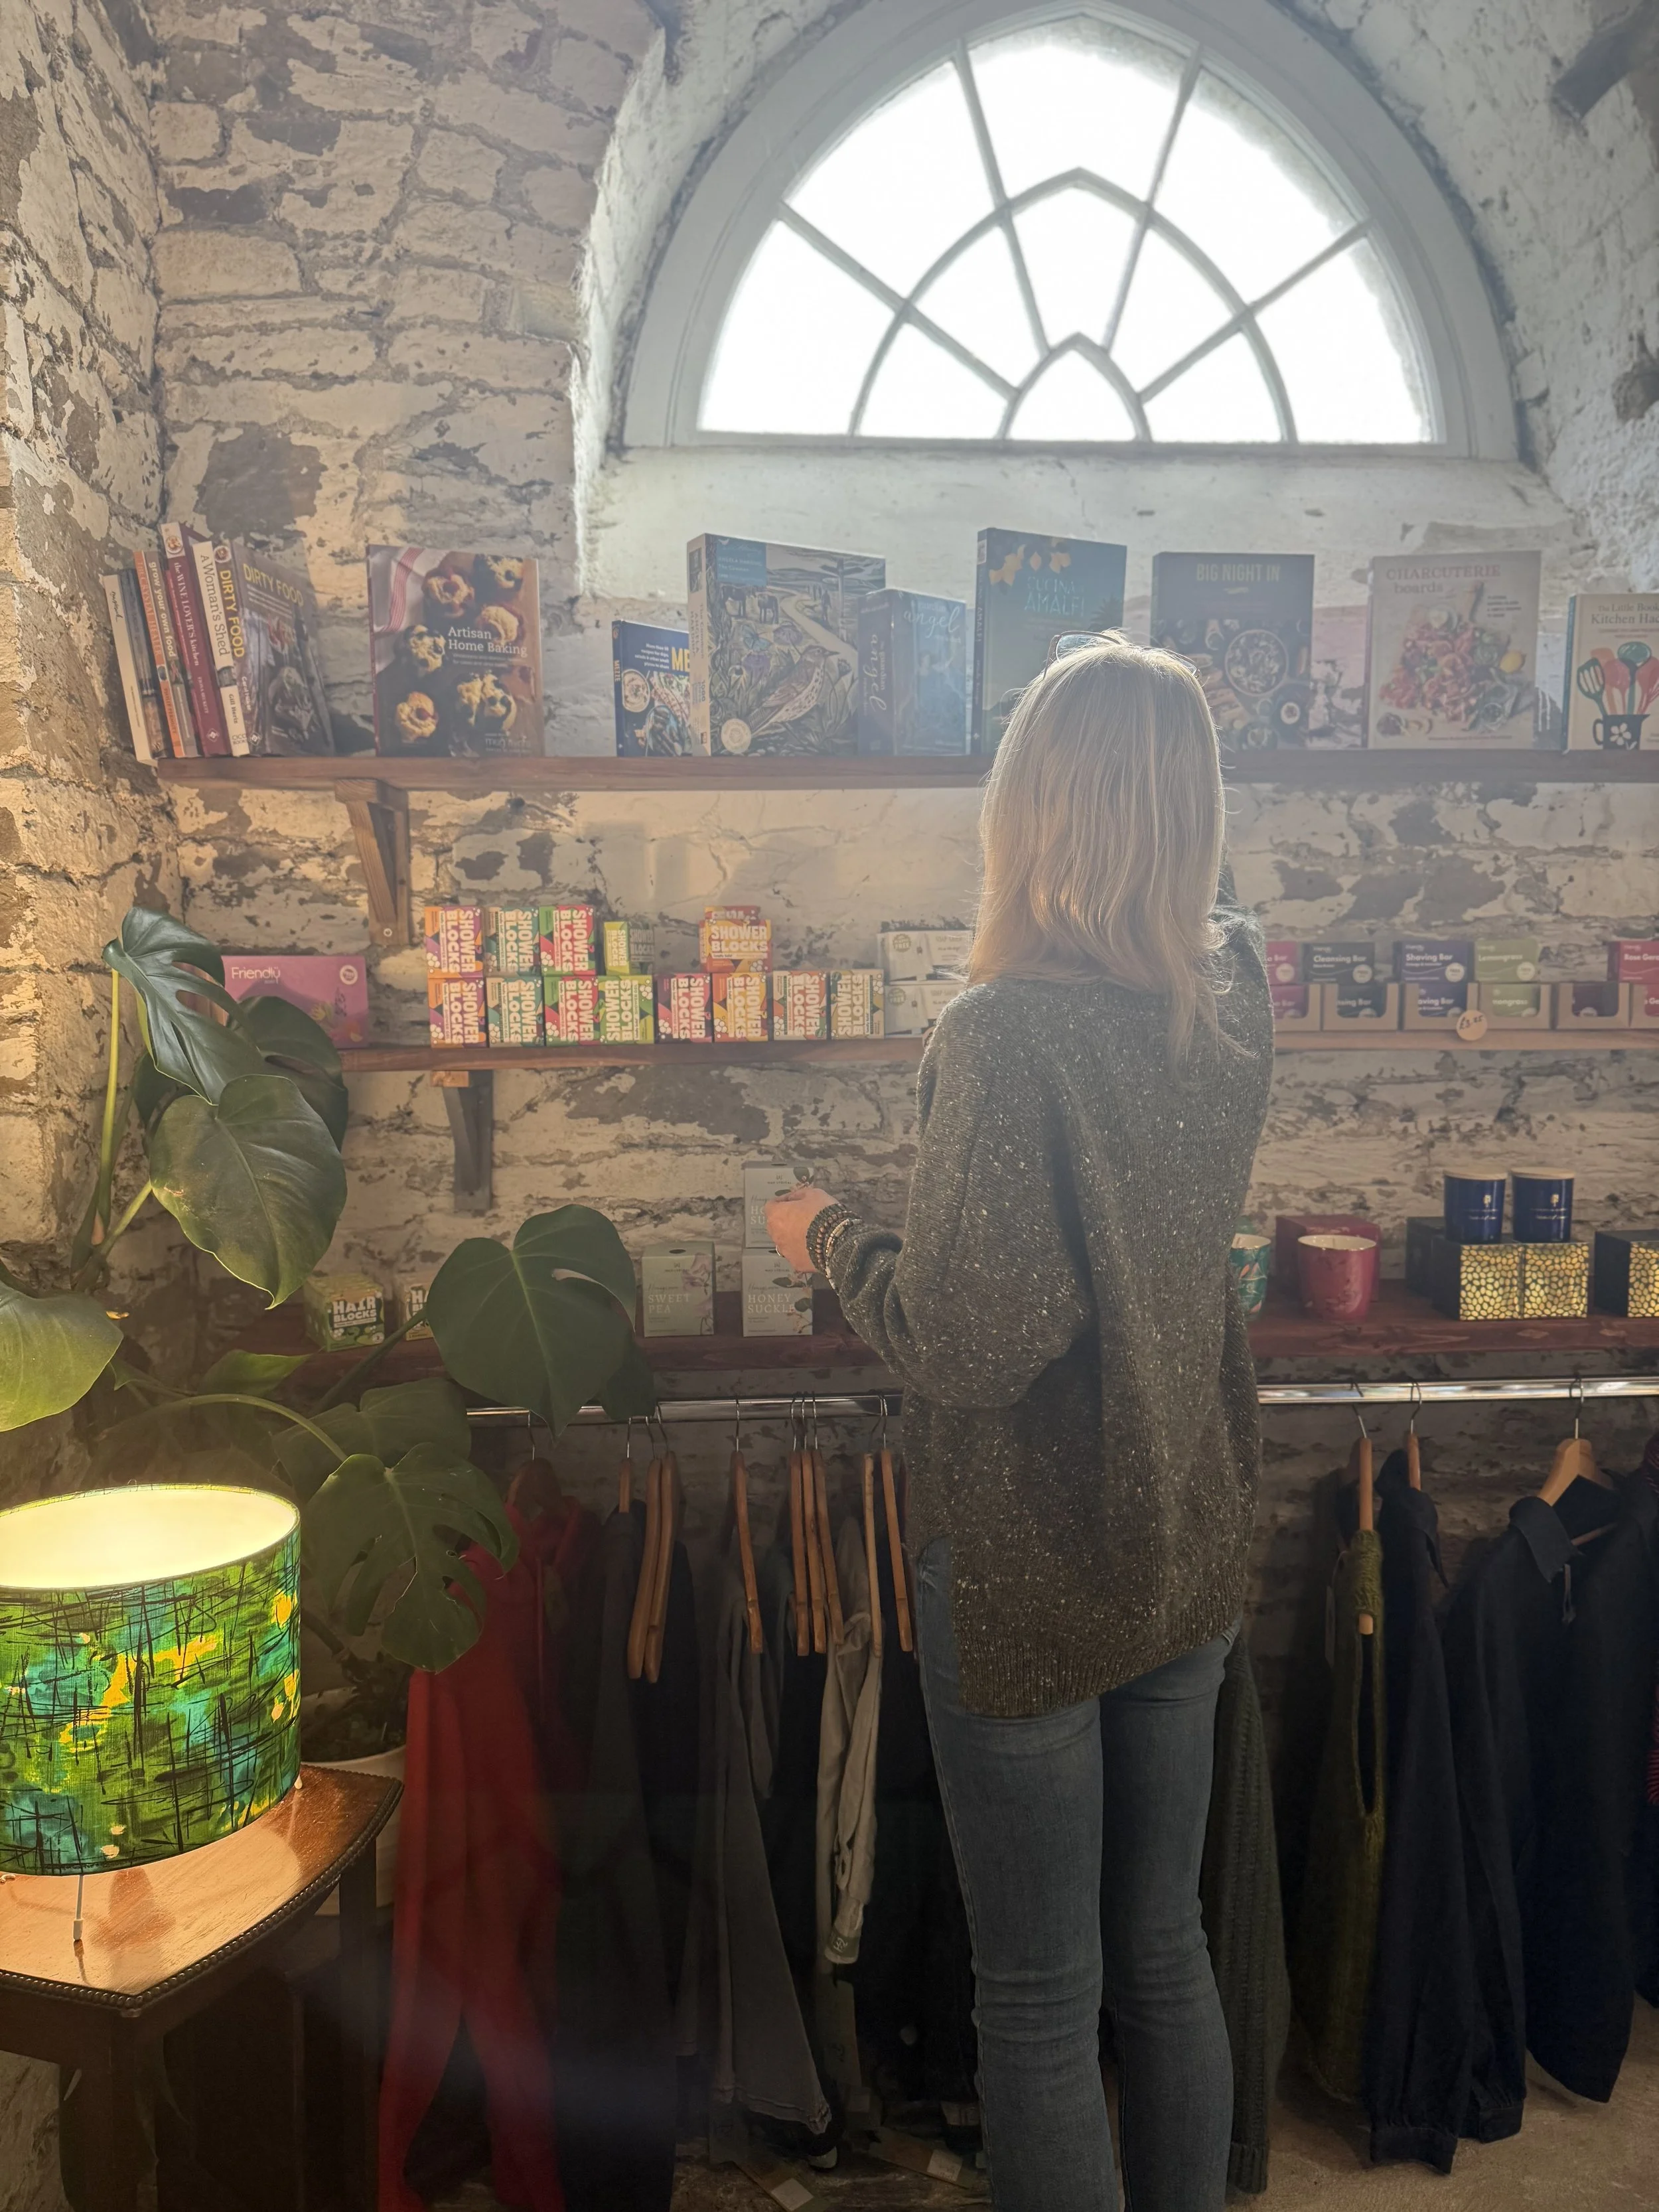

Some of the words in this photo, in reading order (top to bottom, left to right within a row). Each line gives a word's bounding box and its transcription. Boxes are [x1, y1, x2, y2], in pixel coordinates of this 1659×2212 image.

[149, 562, 161, 587] grow
[177, 573, 188, 599] WINE
[242, 563, 273, 592] DIRTY
[276, 580, 304, 607] FOOD
[1027, 576, 1075, 594] CUCINA
[1196, 563, 1218, 581] BIG
[1222, 563, 1263, 582] NIGHT
[1265, 564, 1281, 582] IN
[1386, 564, 1501, 581] CHARCUTERIE
[1394, 581, 1444, 594] boards
[139, 576, 152, 616] CRYSTAL
[154, 589, 165, 610] your
[202, 564, 221, 623] Woman's
[214, 623, 230, 656] Shed
[1024, 591, 1085, 617] AMALFI
[1612, 603, 1634, 612] Little
[160, 613, 170, 634] own
[181, 600, 194, 638] LOVER'S
[220, 569, 237, 612] DIRTY
[229, 617, 245, 658] FOOD
[904, 604, 961, 638] angel
[1591, 613, 1635, 624] Kitchen
[165, 636, 176, 657] food
[447, 626, 492, 640] Artisan
[448, 640, 484, 652] Home
[487, 642, 528, 657] Baking
[189, 639, 200, 666] kitchen
[672, 646, 690, 672] ME
[446, 911, 460, 974] BLOCKS
[459, 910, 476, 972] SHOWER
[506, 911, 518, 972] BLOCKS
[518, 910, 534, 972] SHOWER
[560, 911, 573, 972] BLOCKS
[572, 910, 588, 972] SHOWER
[711, 926, 767, 940] SHOWER
[711, 940, 768, 952] BLOCKS
[1313, 954, 1352, 964] Cleansing
[1405, 953, 1437, 962] Shaving
[449, 982, 464, 1043] BLOCKS
[463, 982, 479, 1043] SHOWER
[508, 982, 522, 1043] BLOCKS
[520, 982, 537, 1042] SHOWER
[565, 980, 579, 1042] BLOCKS
[578, 980, 595, 1041] SHOWER
[605, 980, 620, 1041] SHOWER
[620, 979, 633, 1041] BLOCKS
[678, 978, 691, 1039] BLOCKS
[689, 977, 705, 1038] SHOWER
[733, 977, 747, 1038] BLOCKS
[746, 977, 761, 1037] SHOWER
[793, 975, 805, 1036] BLOCKS
[805, 975, 820, 1035] SHOWER
[837, 975, 852, 1035] SHOWER
[852, 974, 863, 1035] BLOCKS
[1417, 997, 1439, 1006] aving
[332, 1296, 376, 1315] HAIR
[648, 1293, 690, 1303] SWEET
[648, 1304, 671, 1313] PEA
[747, 1304, 795, 1313] SUCKLE
[748, 1293, 792, 1303] HONEY
[333, 1309, 377, 1323] BLOCKS
